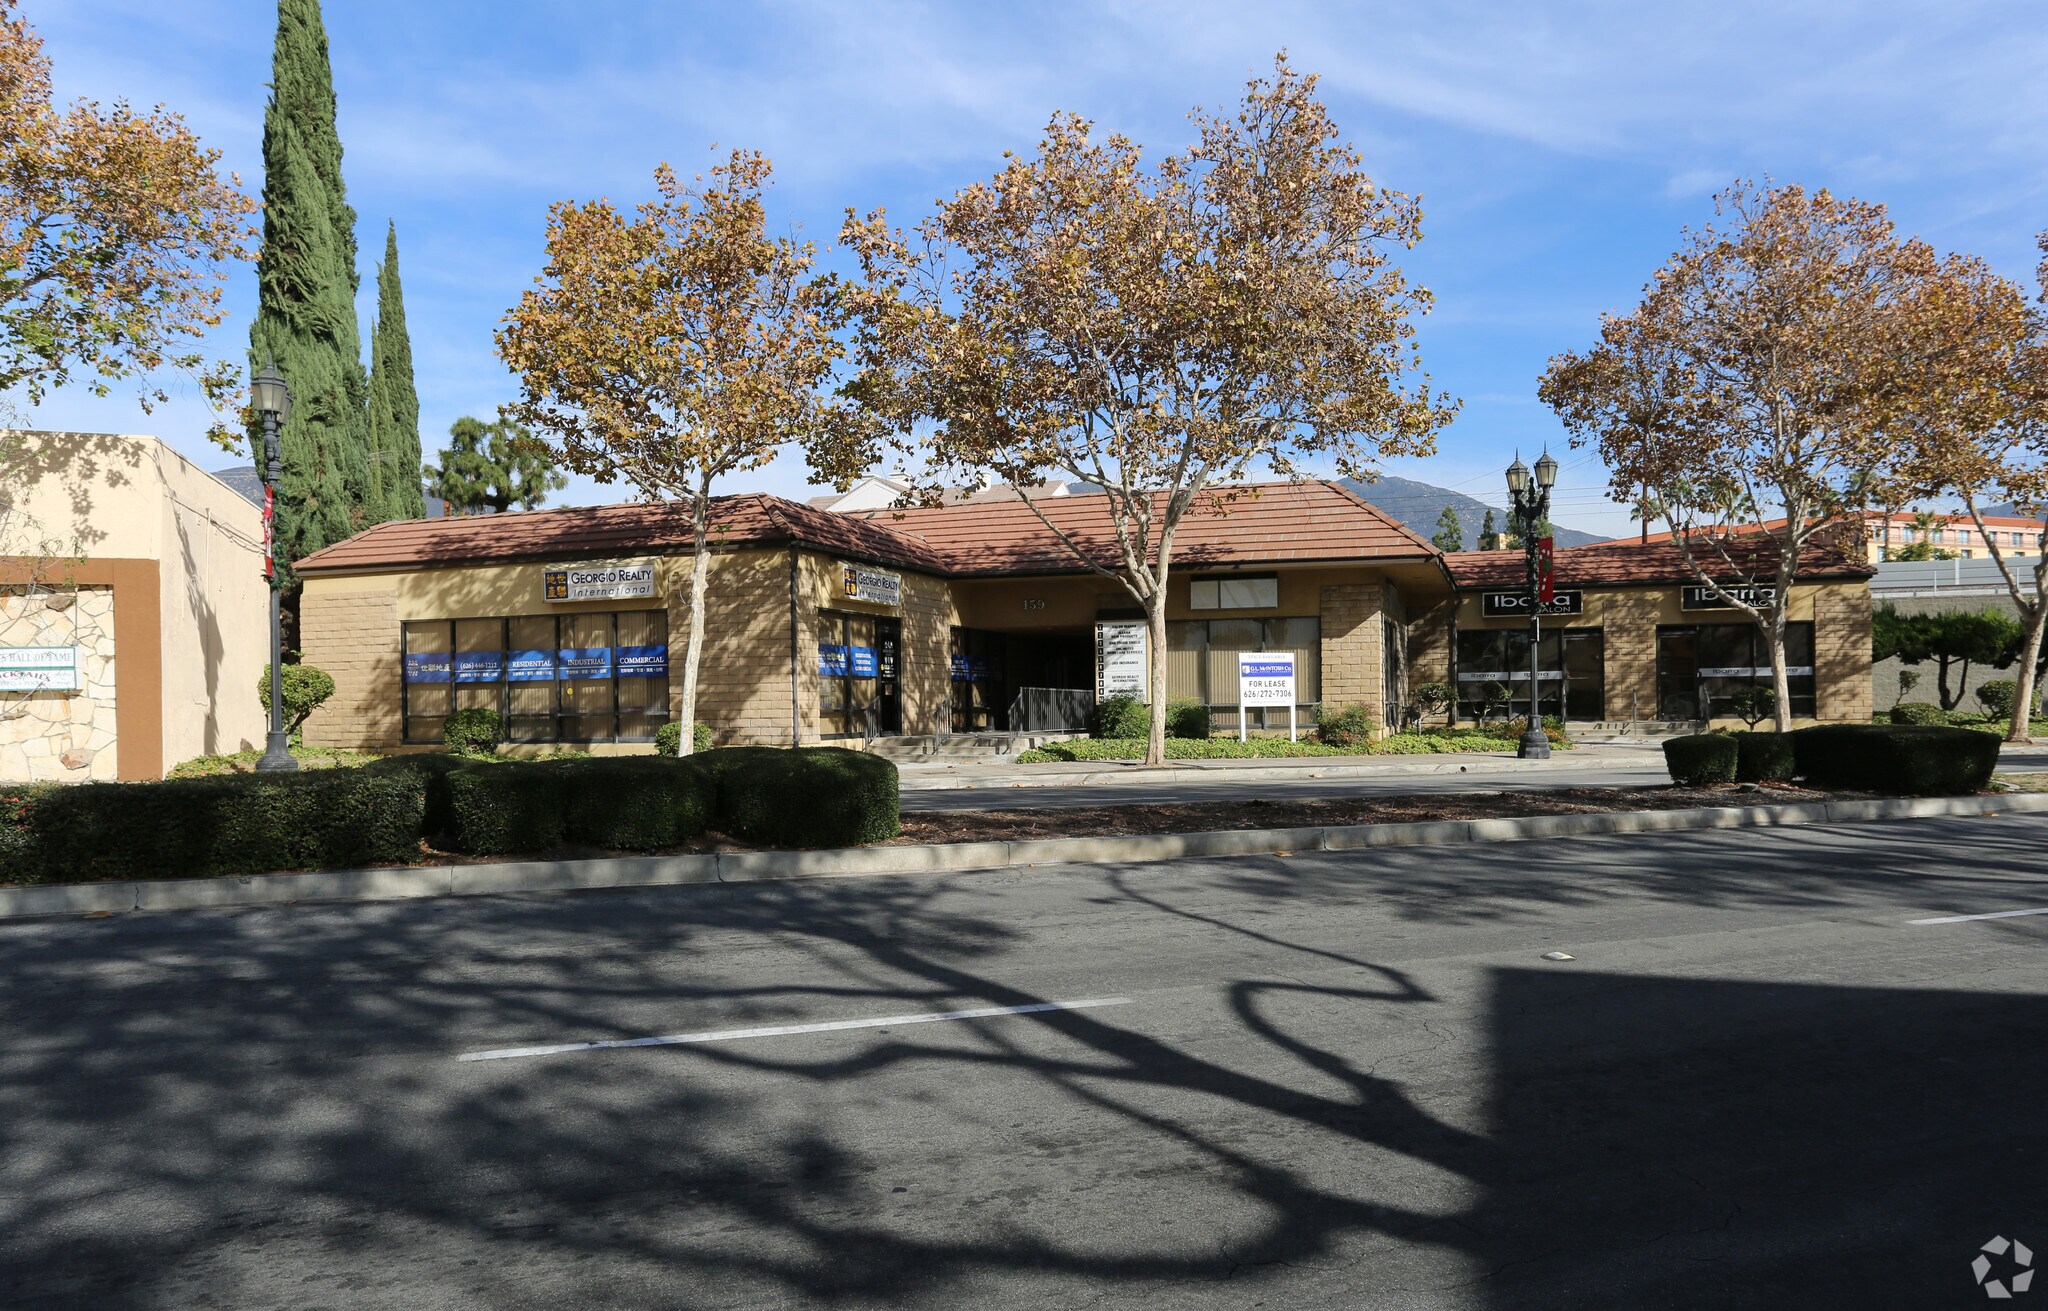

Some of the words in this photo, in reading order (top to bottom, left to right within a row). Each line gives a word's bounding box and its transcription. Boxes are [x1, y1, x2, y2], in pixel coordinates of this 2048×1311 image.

[571, 572, 617, 584] GEORGIO
[619, 570, 652, 582] REALTY
[858, 572, 882, 588] GEORGIO
[882, 577, 899, 591] REALTY
[573, 585, 651, 598] International
[1024, 599, 1045, 610] 159
[8, 652, 31, 662] HALL
[620, 656, 664, 664] COMMERCIAL
[512, 660, 552, 668] RESIDENTIAL
[1244, 690, 1292, 698] 626/272-7306
